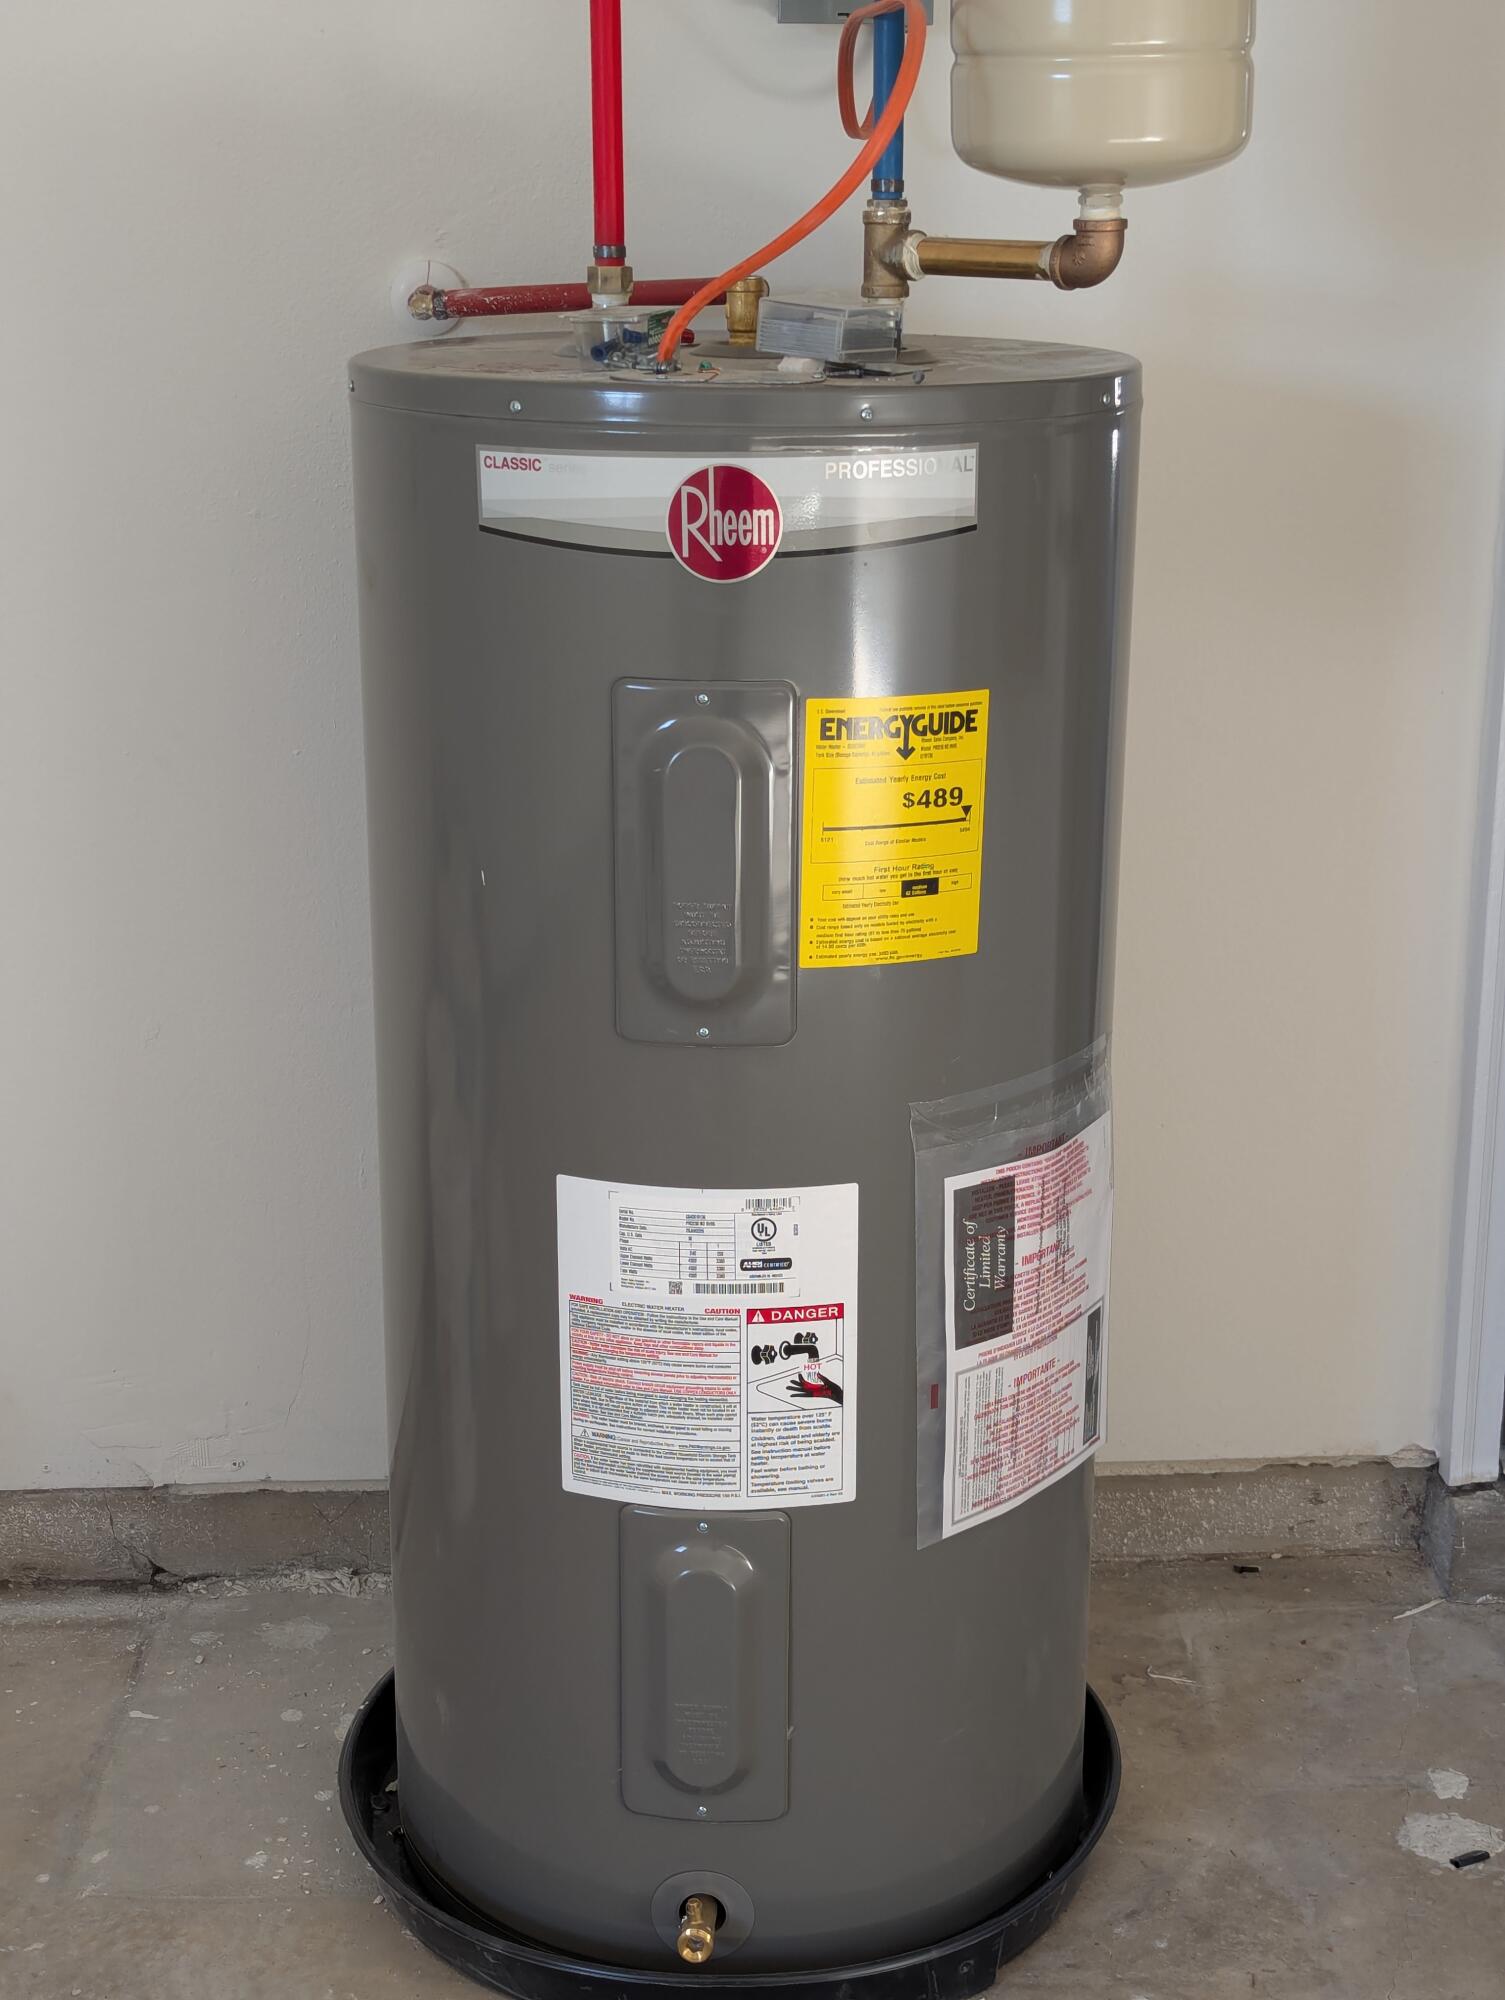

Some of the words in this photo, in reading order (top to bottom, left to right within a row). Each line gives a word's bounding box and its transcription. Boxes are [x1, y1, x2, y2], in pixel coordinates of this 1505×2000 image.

[483, 455, 542, 472] CLASSIC
[824, 454, 974, 480] PROFESSIOAL
[681, 465, 774, 562] Rheem
[820, 709, 978, 741] ENERGYGUIDE
[890, 775, 909, 784] Yearly
[911, 774, 932, 783] Energy
[903, 787, 963, 809] $489
[912, 863, 935, 871] Rating
[757, 1223, 770, 1236] UL
[963, 1218, 978, 1234] of
[978, 1234, 991, 1288] Limited
[994, 1226, 1008, 1290] Warranty
[963, 1239, 978, 1311] Certificate
[569, 1294, 603, 1304] WARNING
[771, 1306, 839, 1320] DANGER
[804, 1363, 822, 1371] HOT
[1014, 1357, 1057, 1388] IMPORTANTE
